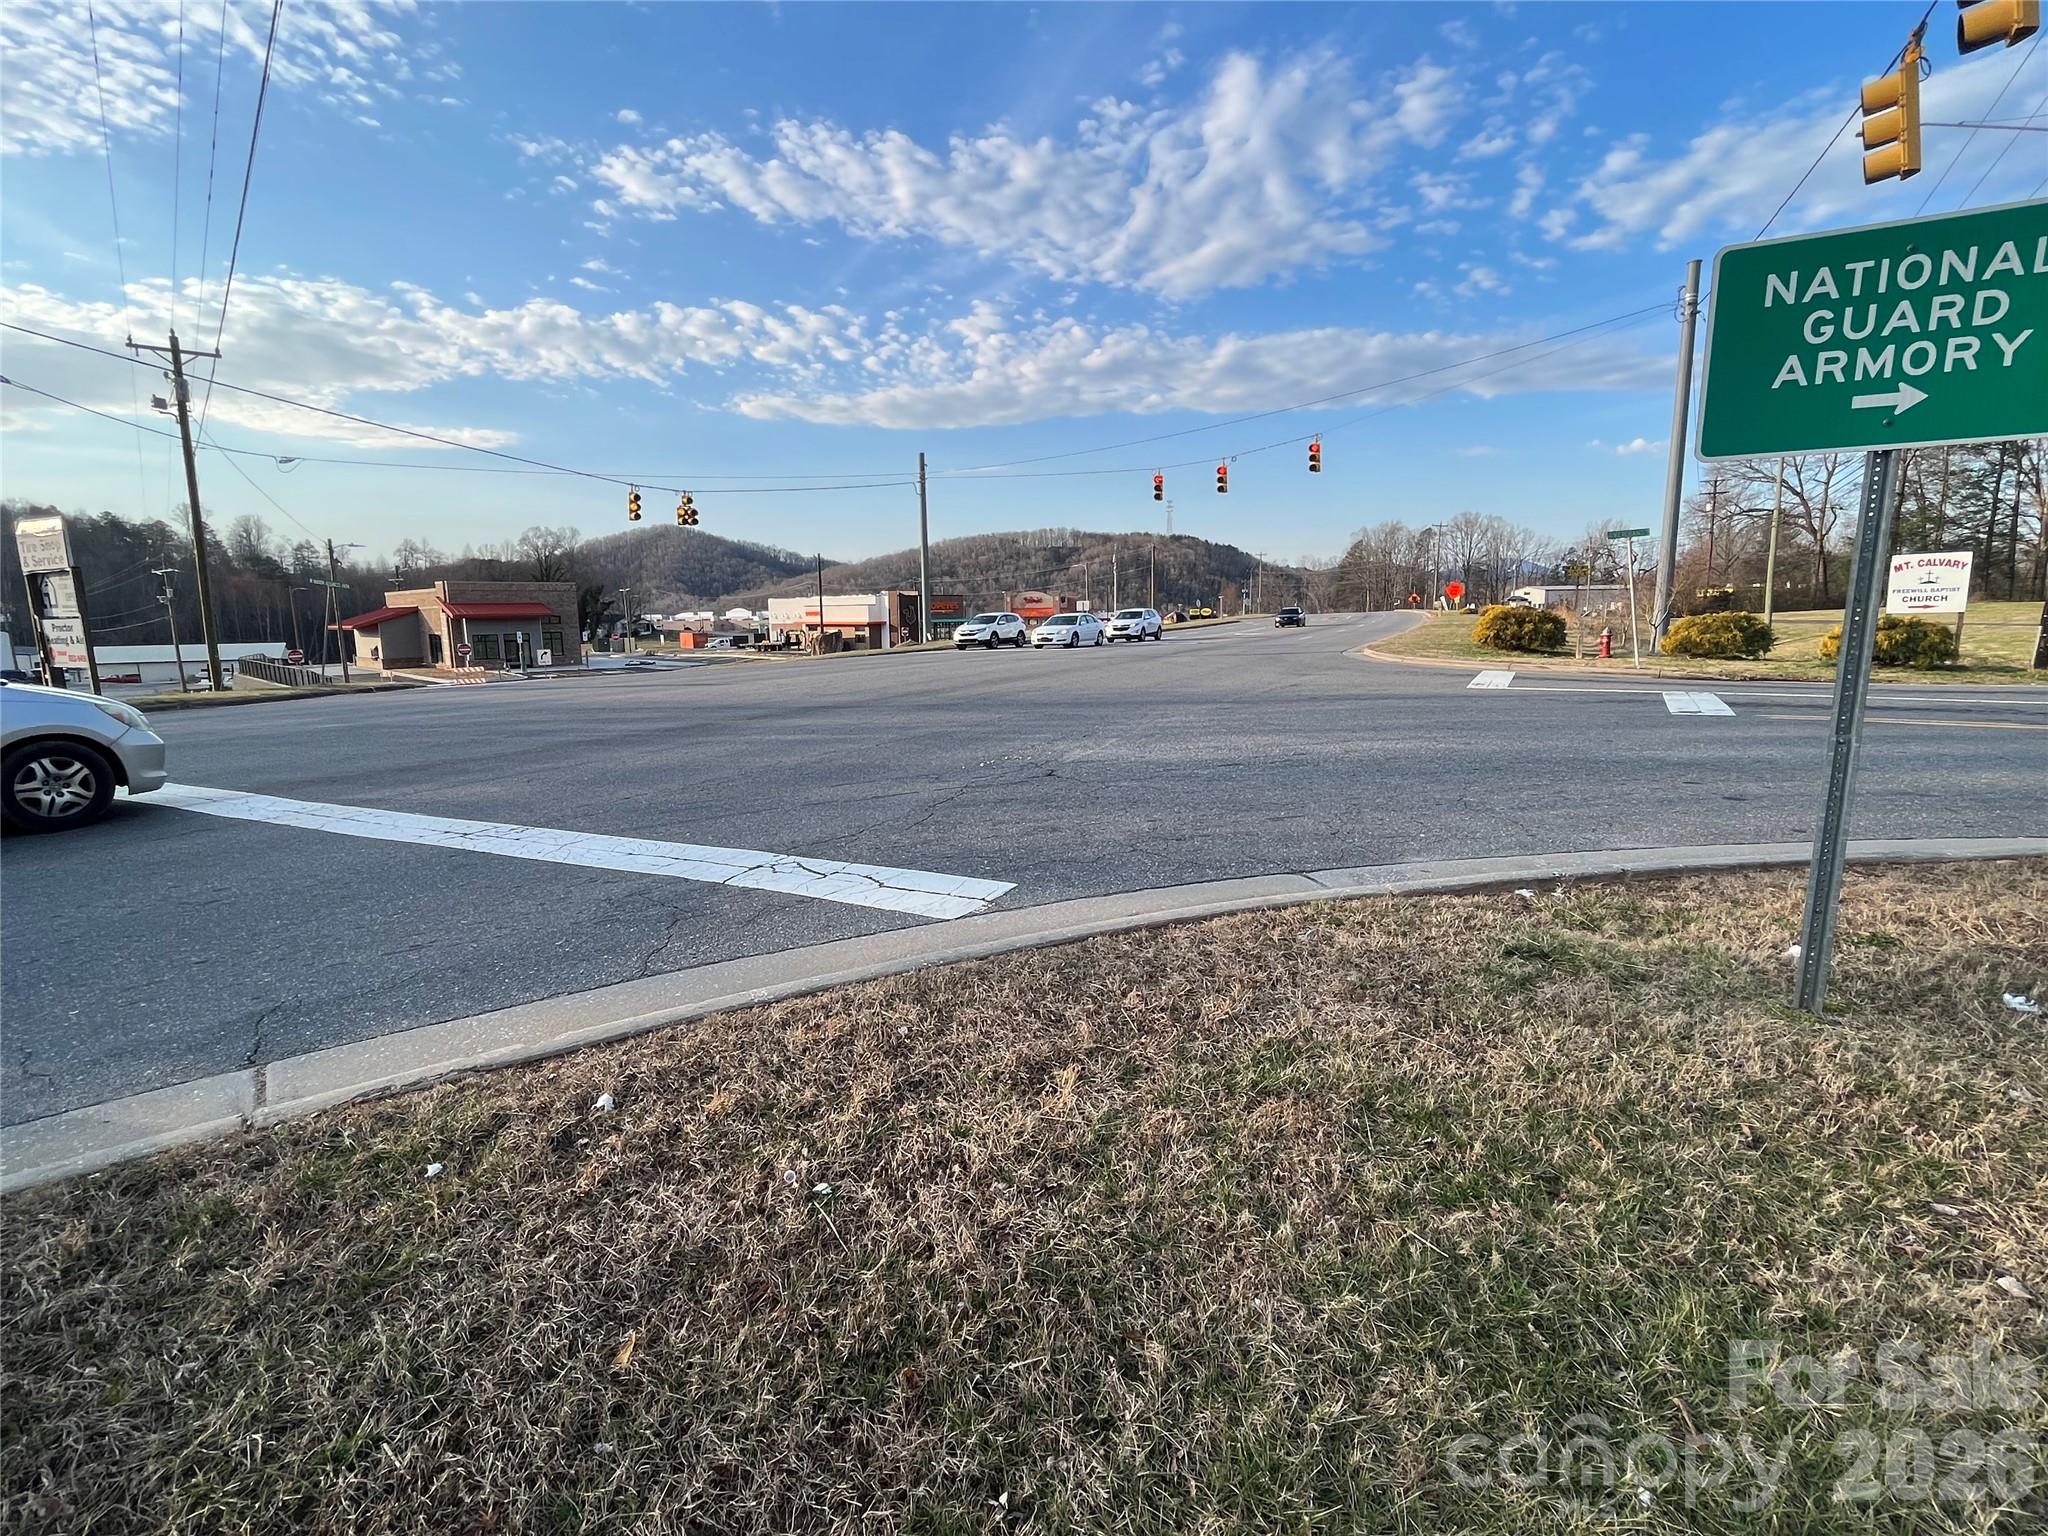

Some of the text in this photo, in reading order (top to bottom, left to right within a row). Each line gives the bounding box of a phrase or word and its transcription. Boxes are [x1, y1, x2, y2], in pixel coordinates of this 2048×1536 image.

[1764, 236, 2048, 308] NATIONAL
[1803, 290, 2011, 345] GUARD
[1771, 329, 2033, 390] ARMORY
[31, 554, 65, 567] Service
[1893, 558, 1969, 573] MT. CALVARY
[1902, 595, 1949, 603] CHURCH
